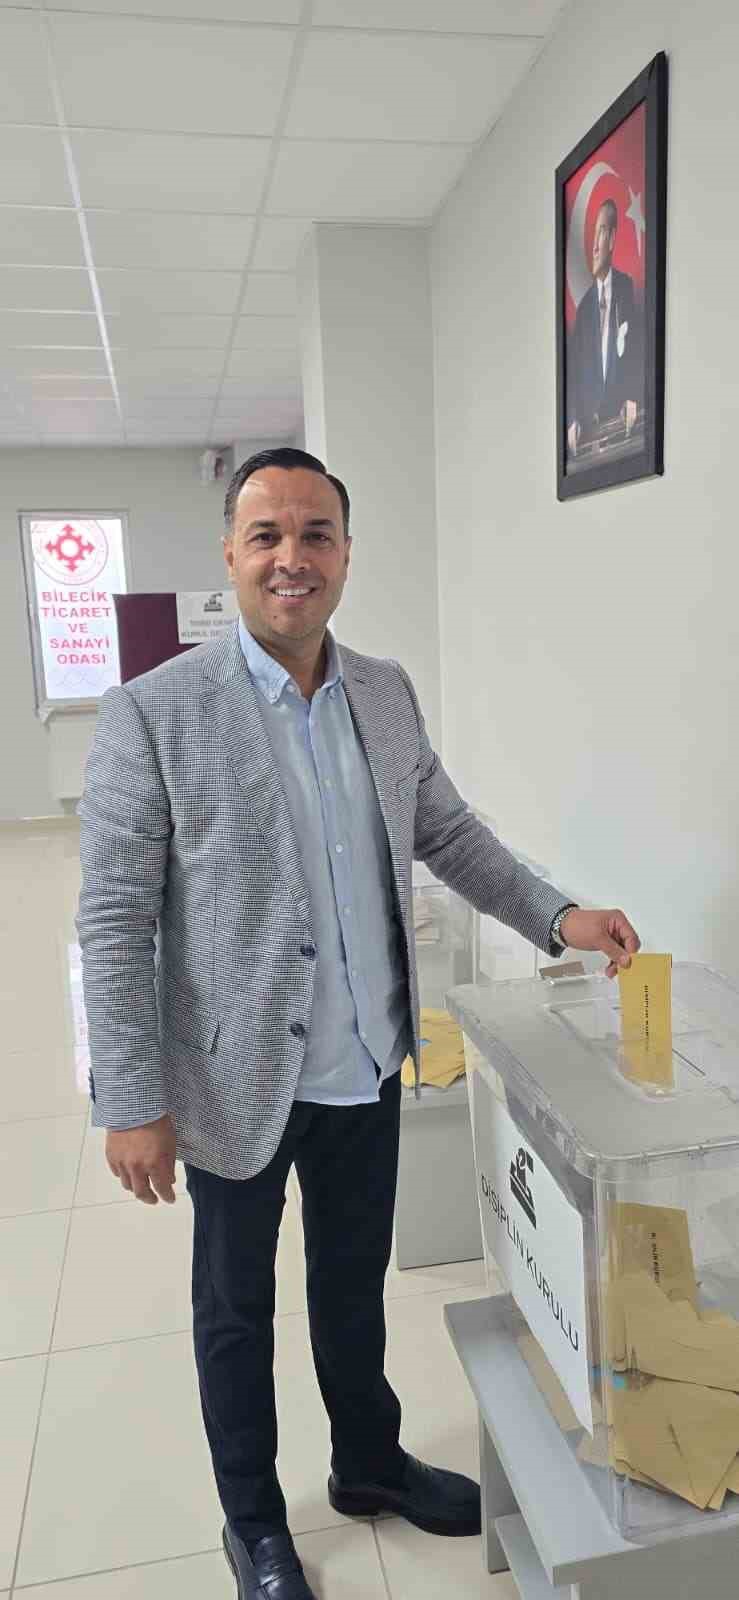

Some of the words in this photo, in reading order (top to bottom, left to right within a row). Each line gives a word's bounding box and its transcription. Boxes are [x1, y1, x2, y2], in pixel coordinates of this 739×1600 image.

[42, 588, 107, 602] BİLECİK
[41, 604, 112, 617] TİCARET
[68, 623, 89, 634] VE
[49, 636, 110, 649] SANAYİ
[57, 654, 106, 665] ODASI
[527, 1248, 579, 1352] KURULU
